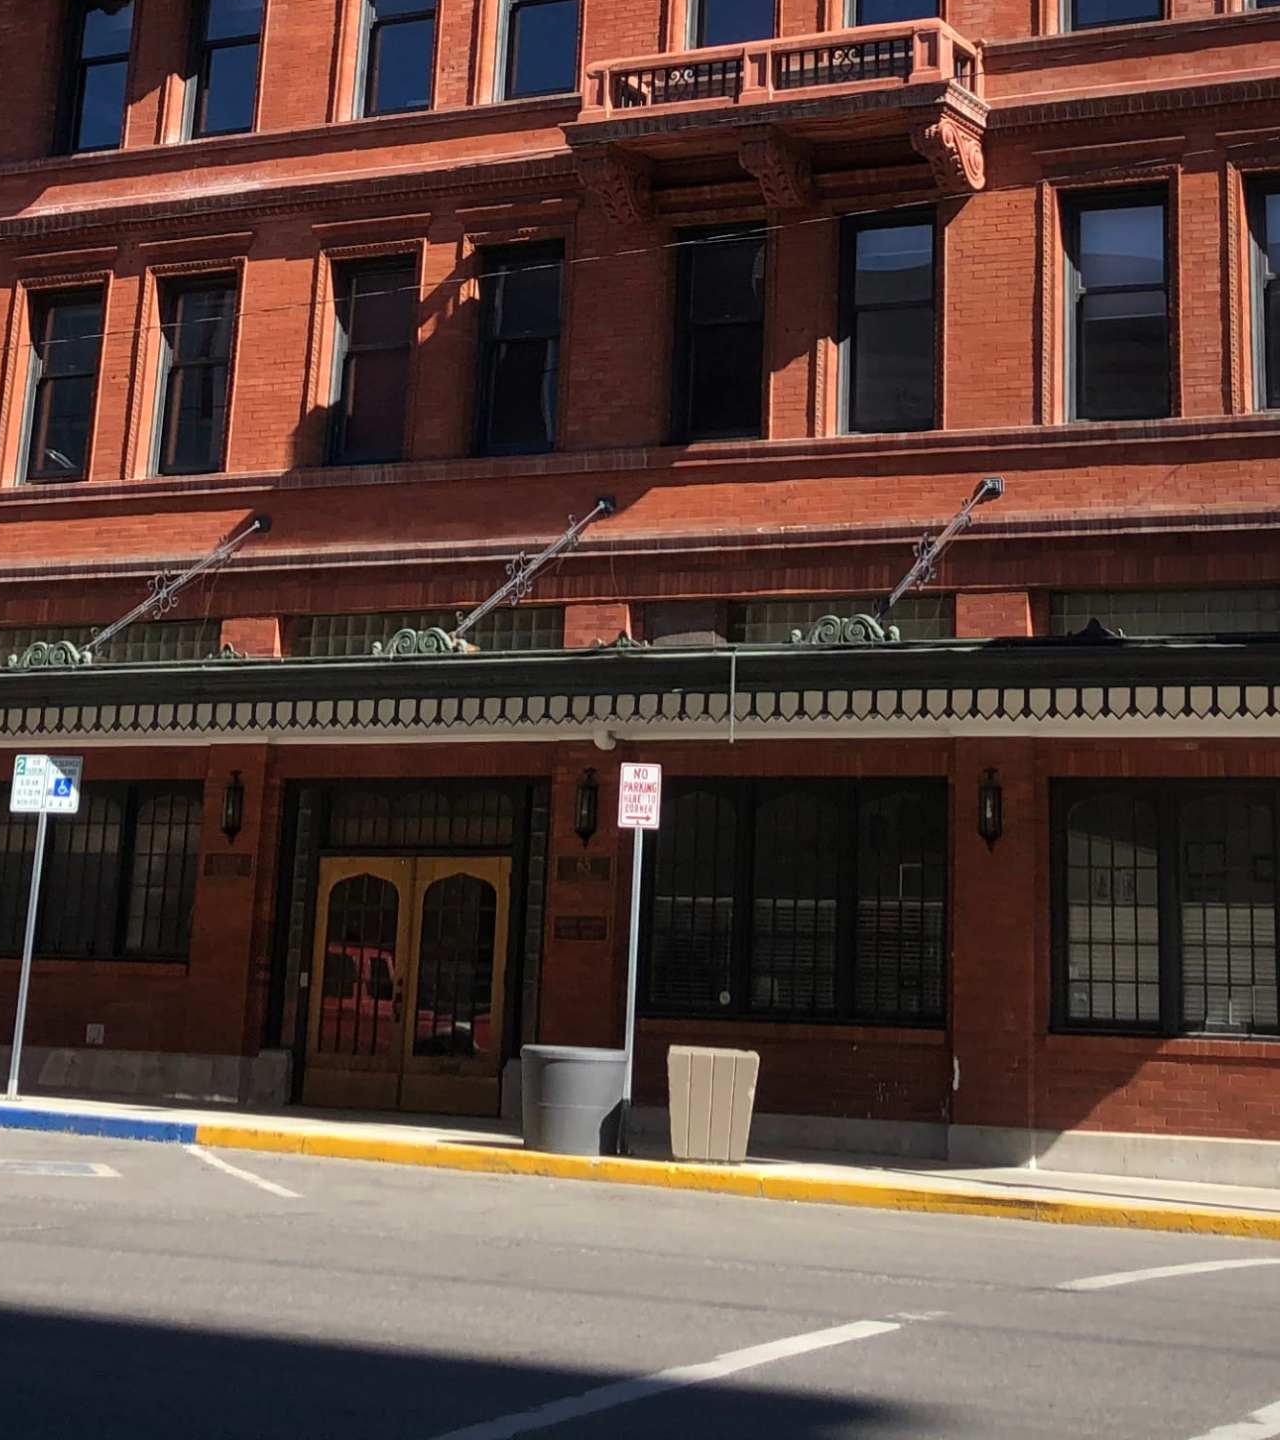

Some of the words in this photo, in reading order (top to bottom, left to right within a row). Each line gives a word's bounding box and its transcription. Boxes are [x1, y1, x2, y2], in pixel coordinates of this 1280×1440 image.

[633, 768, 649, 779] NO
[623, 781, 657, 793] PARKING
[625, 804, 652, 813] CORNER
